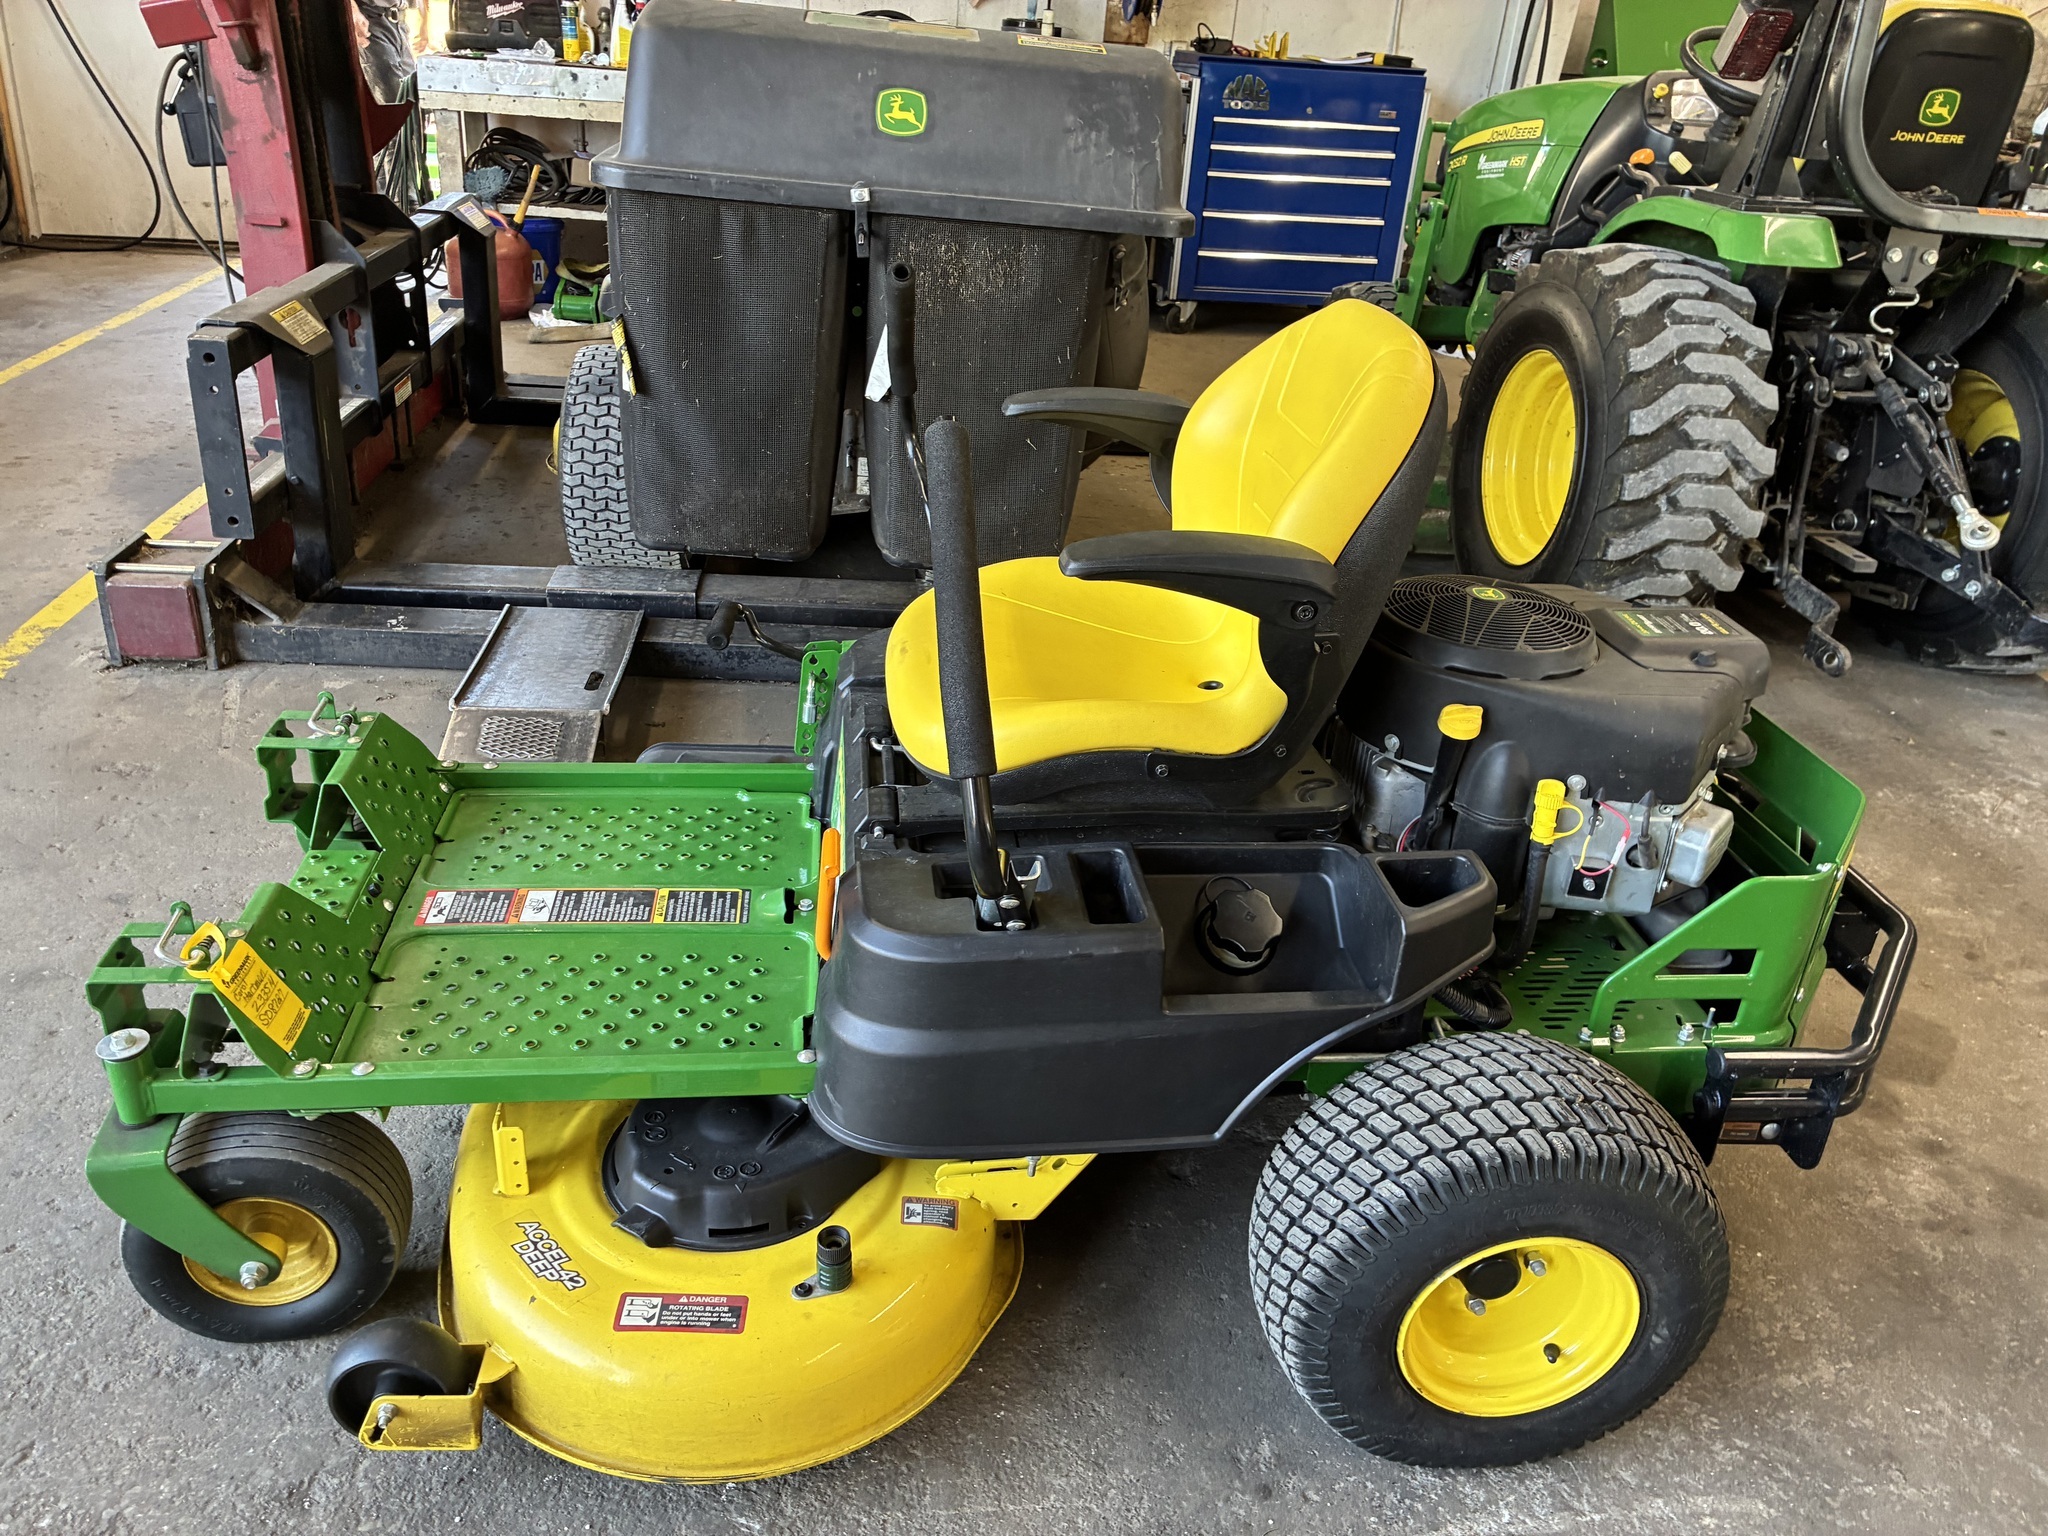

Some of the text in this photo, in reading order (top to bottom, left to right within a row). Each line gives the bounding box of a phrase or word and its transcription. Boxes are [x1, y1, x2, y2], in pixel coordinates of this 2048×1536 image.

[485, 1, 524, 17] Milwaukee
[1222, 73, 1270, 100] MAC
[1221, 99, 1270, 111] TOOLS
[1487, 126, 1540, 142] JOHN DEERE
[1890, 129, 1966, 144] JOHN DEERE
[1509, 156, 1528, 167] HST
[656, 895, 667, 913] CAUTION
[229, 955, 251, 985] GREENMARK
[915, 1197, 955, 1205] WARNING
[510, 1239, 561, 1282] DEEP
[515, 1221, 587, 1292] ACCEL 42
